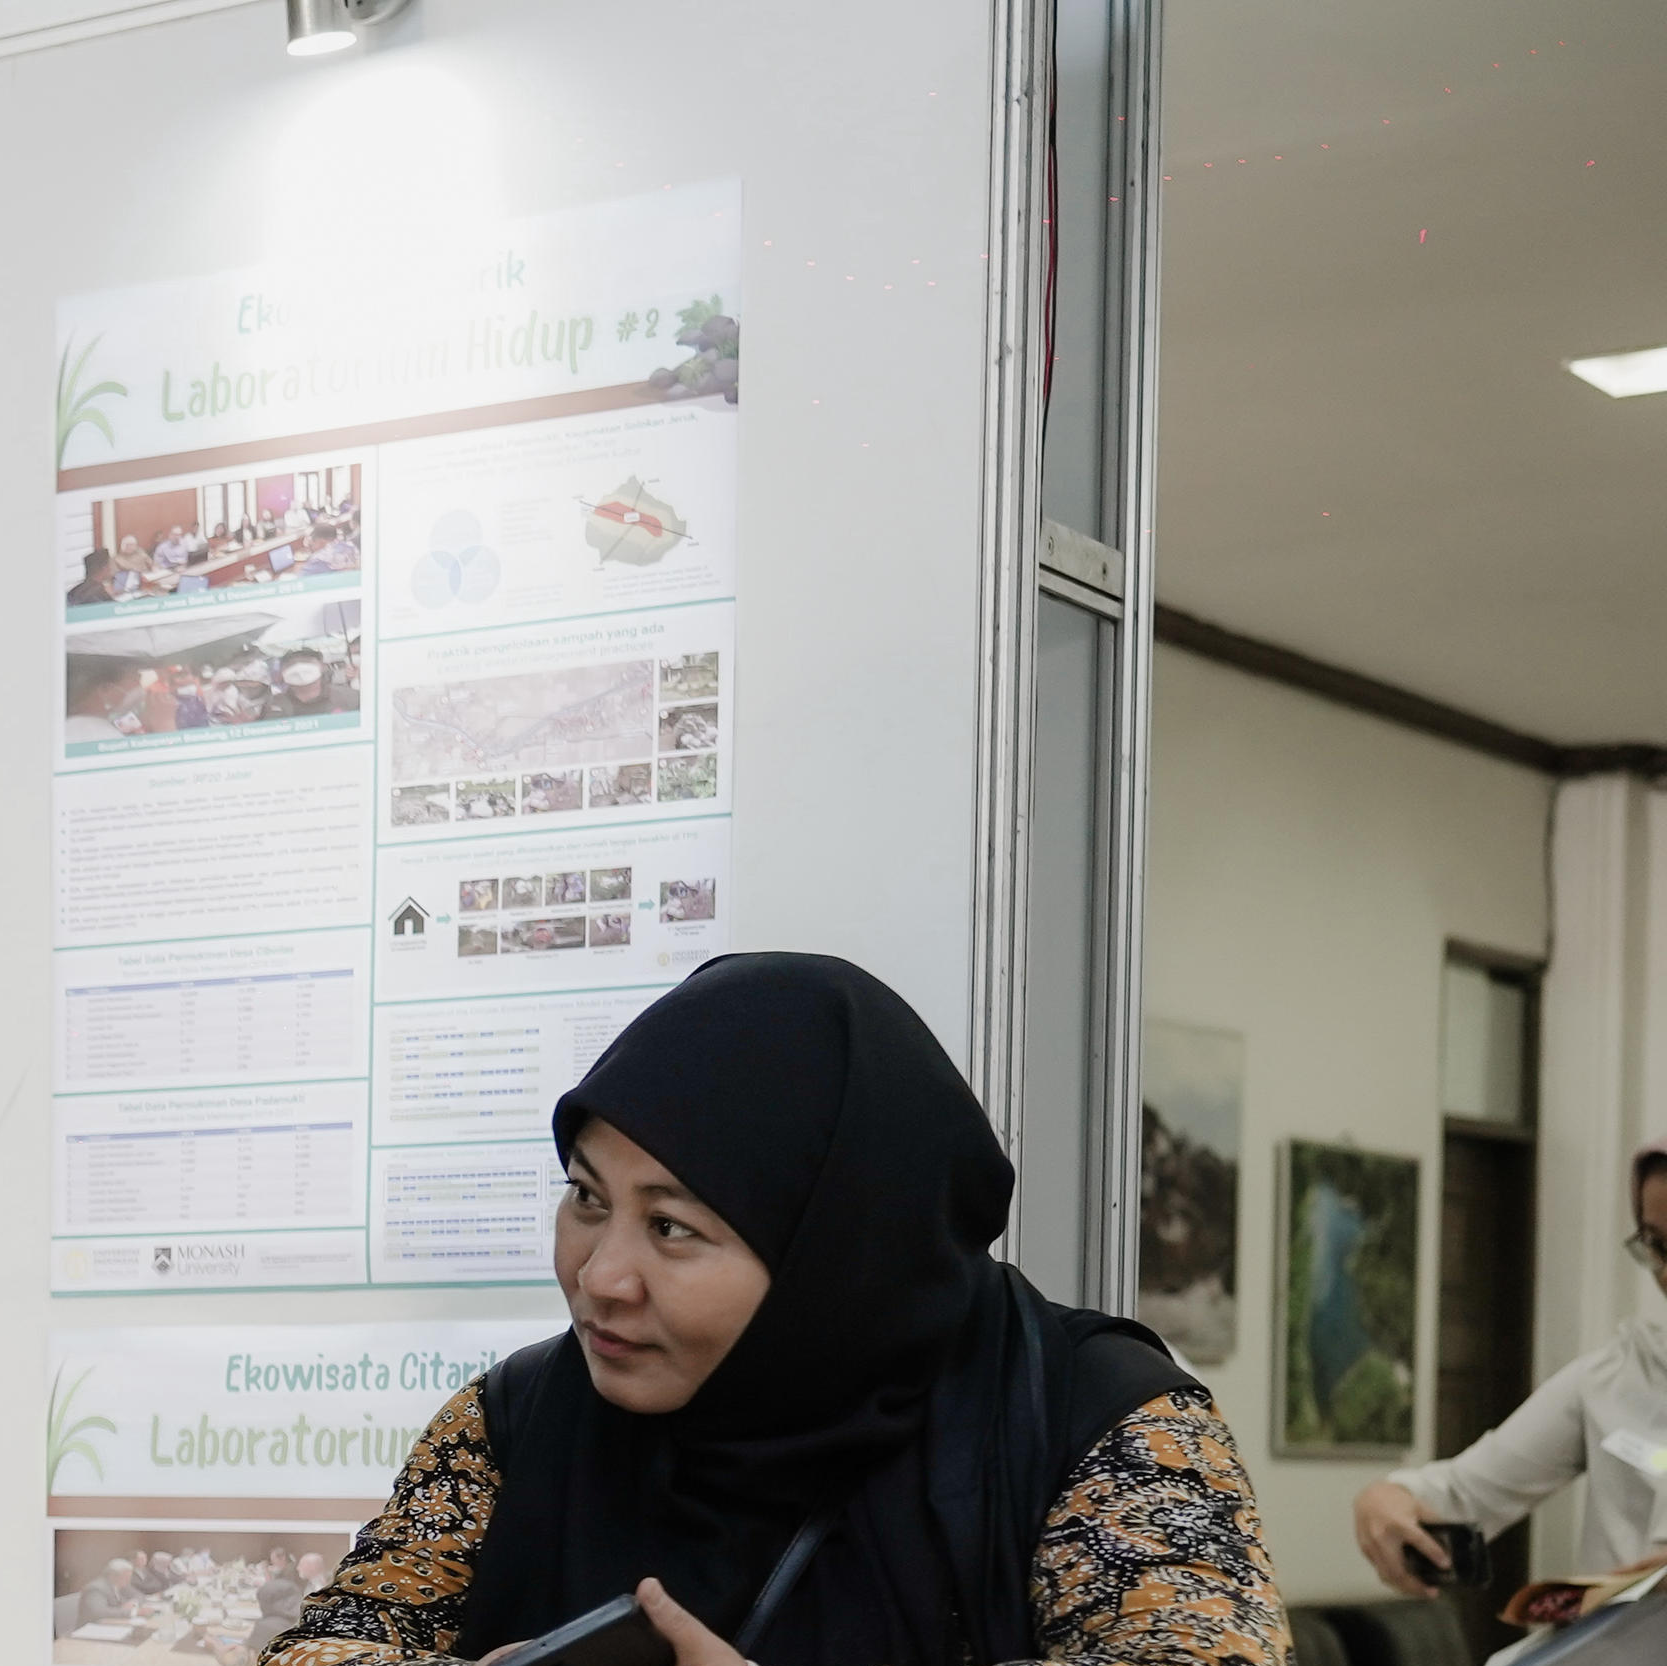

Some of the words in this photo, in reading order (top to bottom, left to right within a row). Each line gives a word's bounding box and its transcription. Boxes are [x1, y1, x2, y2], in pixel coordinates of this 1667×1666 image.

[467, 305, 594, 376] Hidup
[615, 307, 660, 343] #2
[641, 621, 665, 636] ada
[178, 1243, 245, 1259] MONASH
[178, 1260, 240, 1277] University
[226, 1352, 390, 1391] Ekowisata
